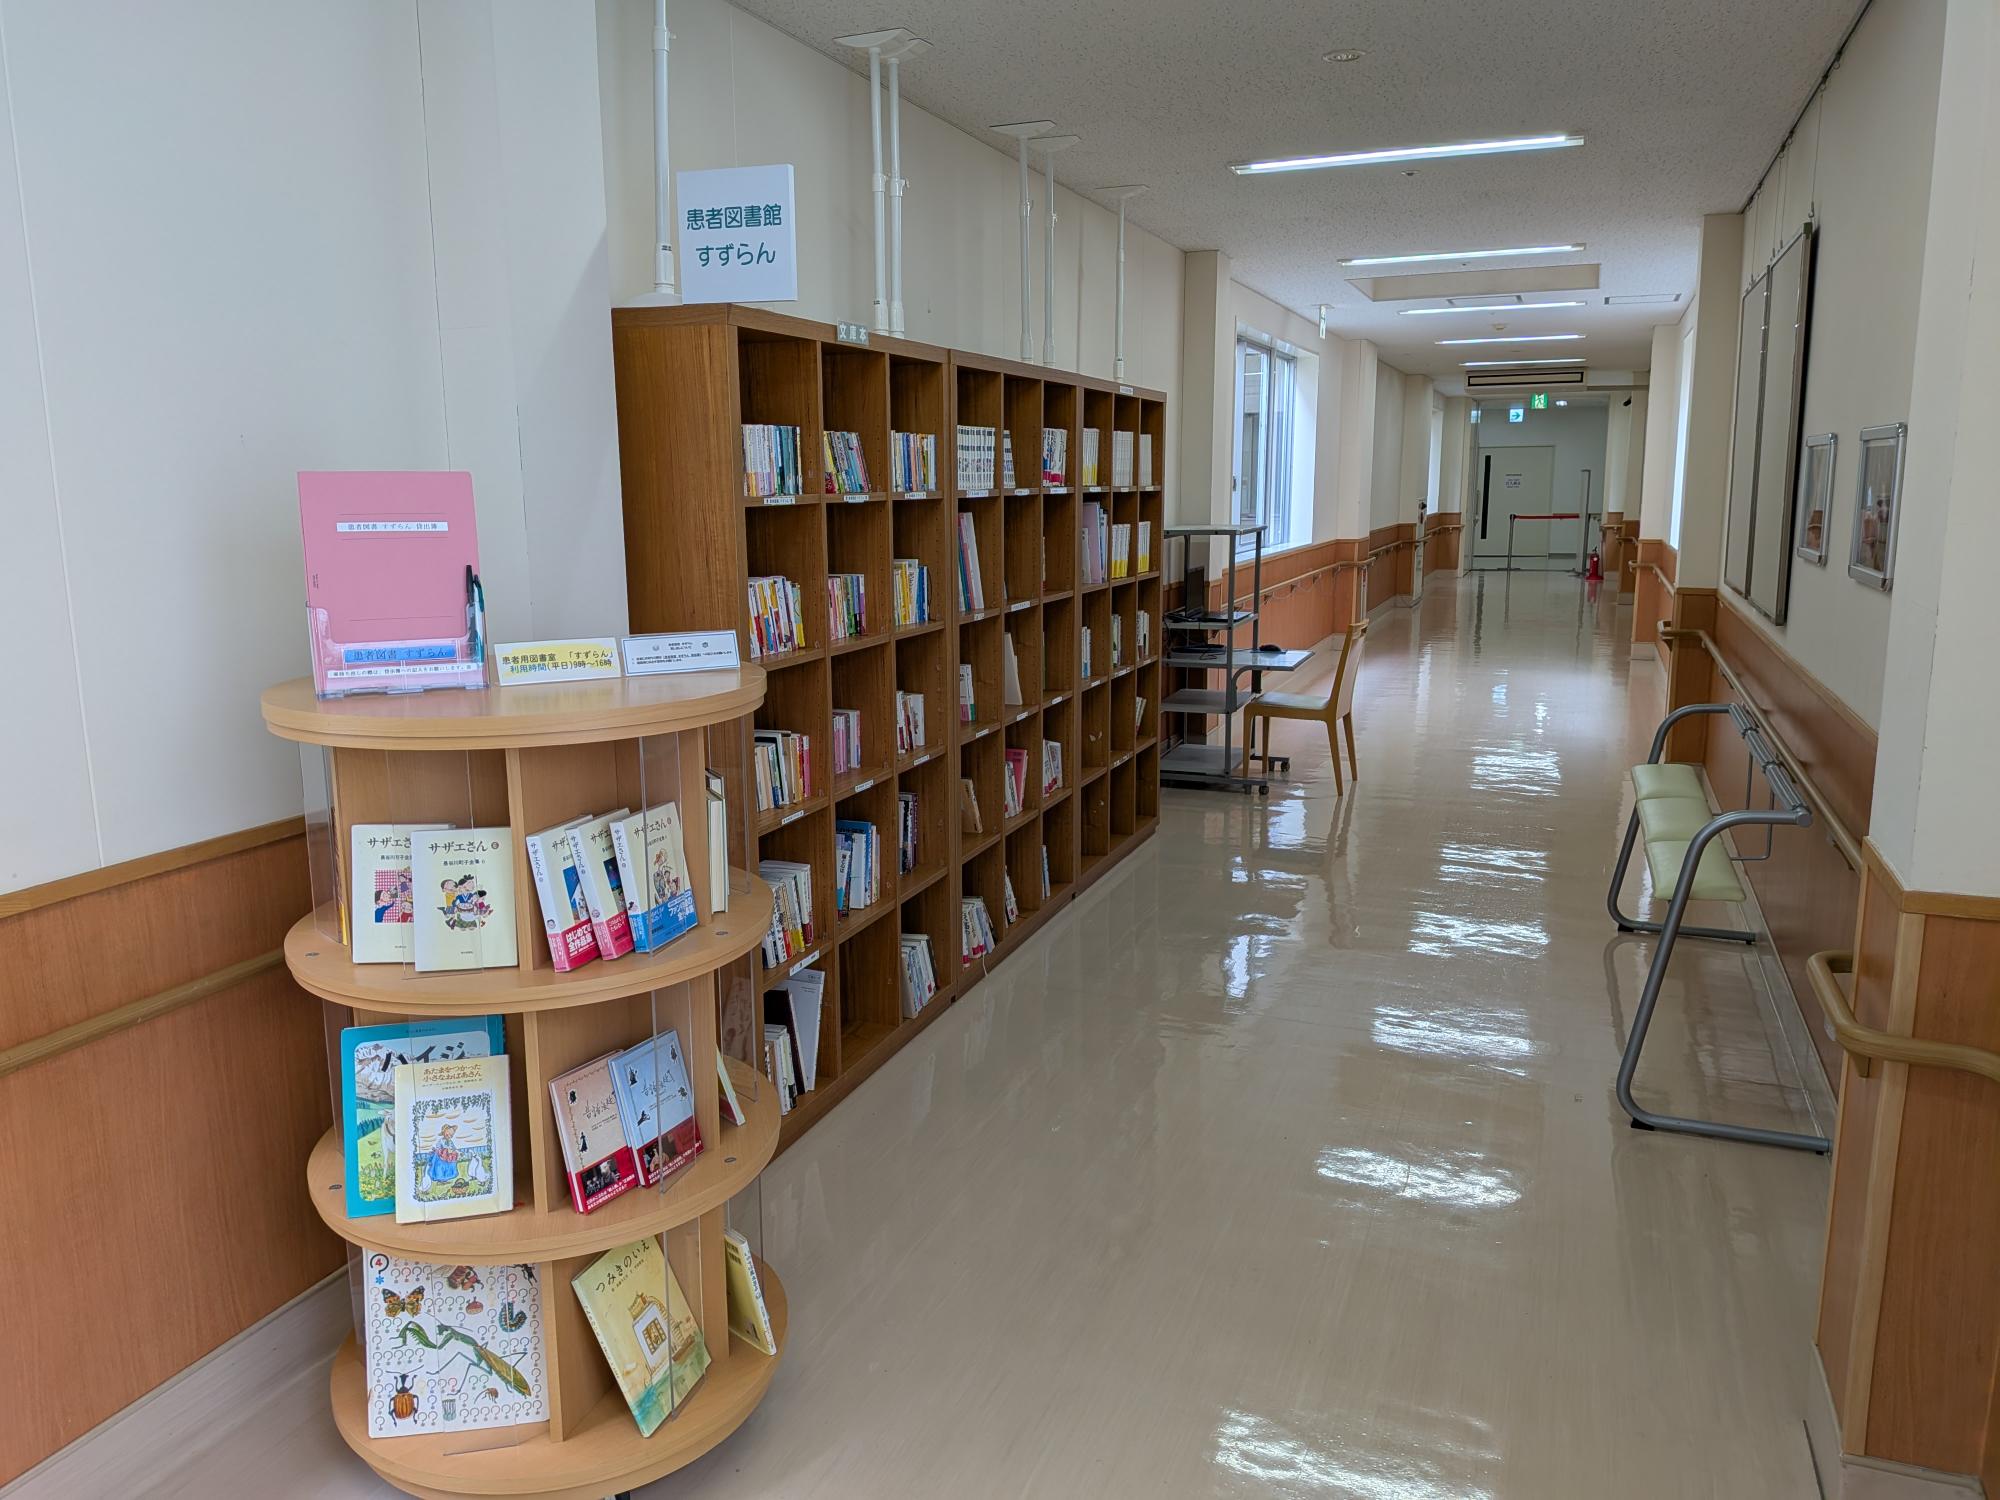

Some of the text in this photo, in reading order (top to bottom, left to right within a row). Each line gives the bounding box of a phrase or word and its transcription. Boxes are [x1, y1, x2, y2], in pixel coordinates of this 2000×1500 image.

[687, 203, 782, 231] 患者図書館
[696, 242, 776, 267] すずらん
[838, 322, 868, 343] 文庫本
[353, 647, 447, 660] 患者図書 すずらん
[502, 650, 614, 665] 患者用図書室 「すずらん」
[634, 818, 668, 840] サザエさん
[428, 840, 488, 854] サザエさん
[571, 835, 585, 869] サザエさん
[614, 829, 626, 862] サザエさん
[531, 841, 543, 877] サザエさん
[422, 1070, 483, 1083] 小さなおばあさん
[423, 1063, 481, 1076] あたまをつかった
[375, 1258, 383, 1266] 4
[596, 1240, 650, 1293] つみきのいえ
